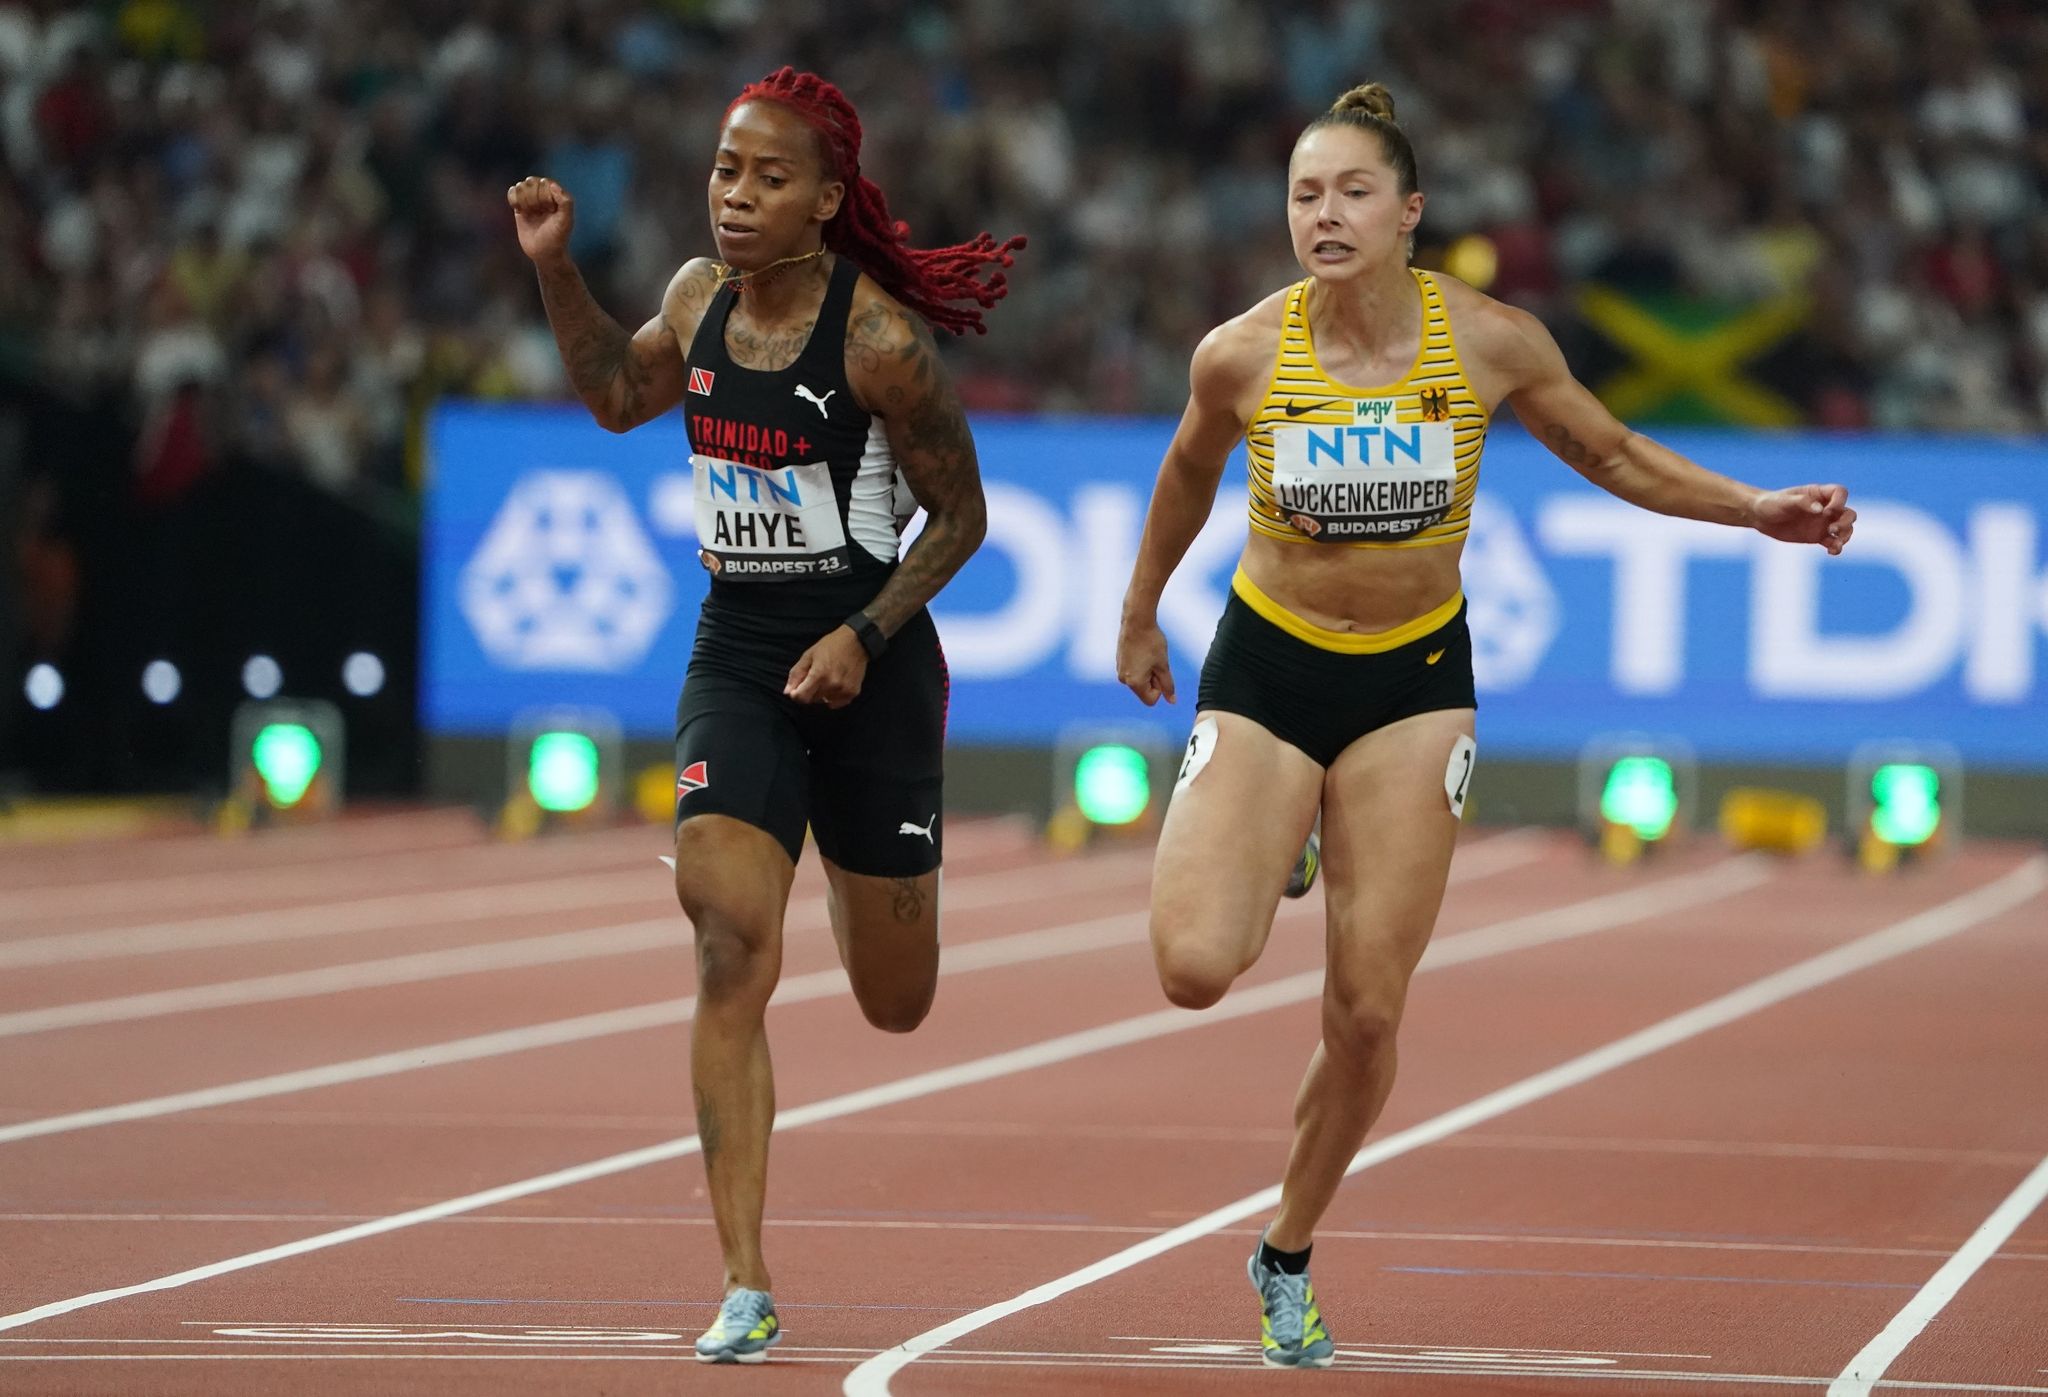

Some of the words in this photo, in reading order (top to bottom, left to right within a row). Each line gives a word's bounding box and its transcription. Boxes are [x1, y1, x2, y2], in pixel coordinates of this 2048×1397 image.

[693, 415, 787, 457] TRINIDAD
[793, 436, 812, 456] +
[1308, 425, 1421, 467] NTN
[709, 463, 802, 507] NTN
[1280, 478, 1448, 513] LÜCKENKEMPER
[714, 511, 806, 547] AHYE
[1327, 518, 1421, 535] BUDAPEST
[725, 561, 815, 574] BUDAPEST
[819, 556, 840, 571] 23
[1454, 749, 1471, 804] 2
